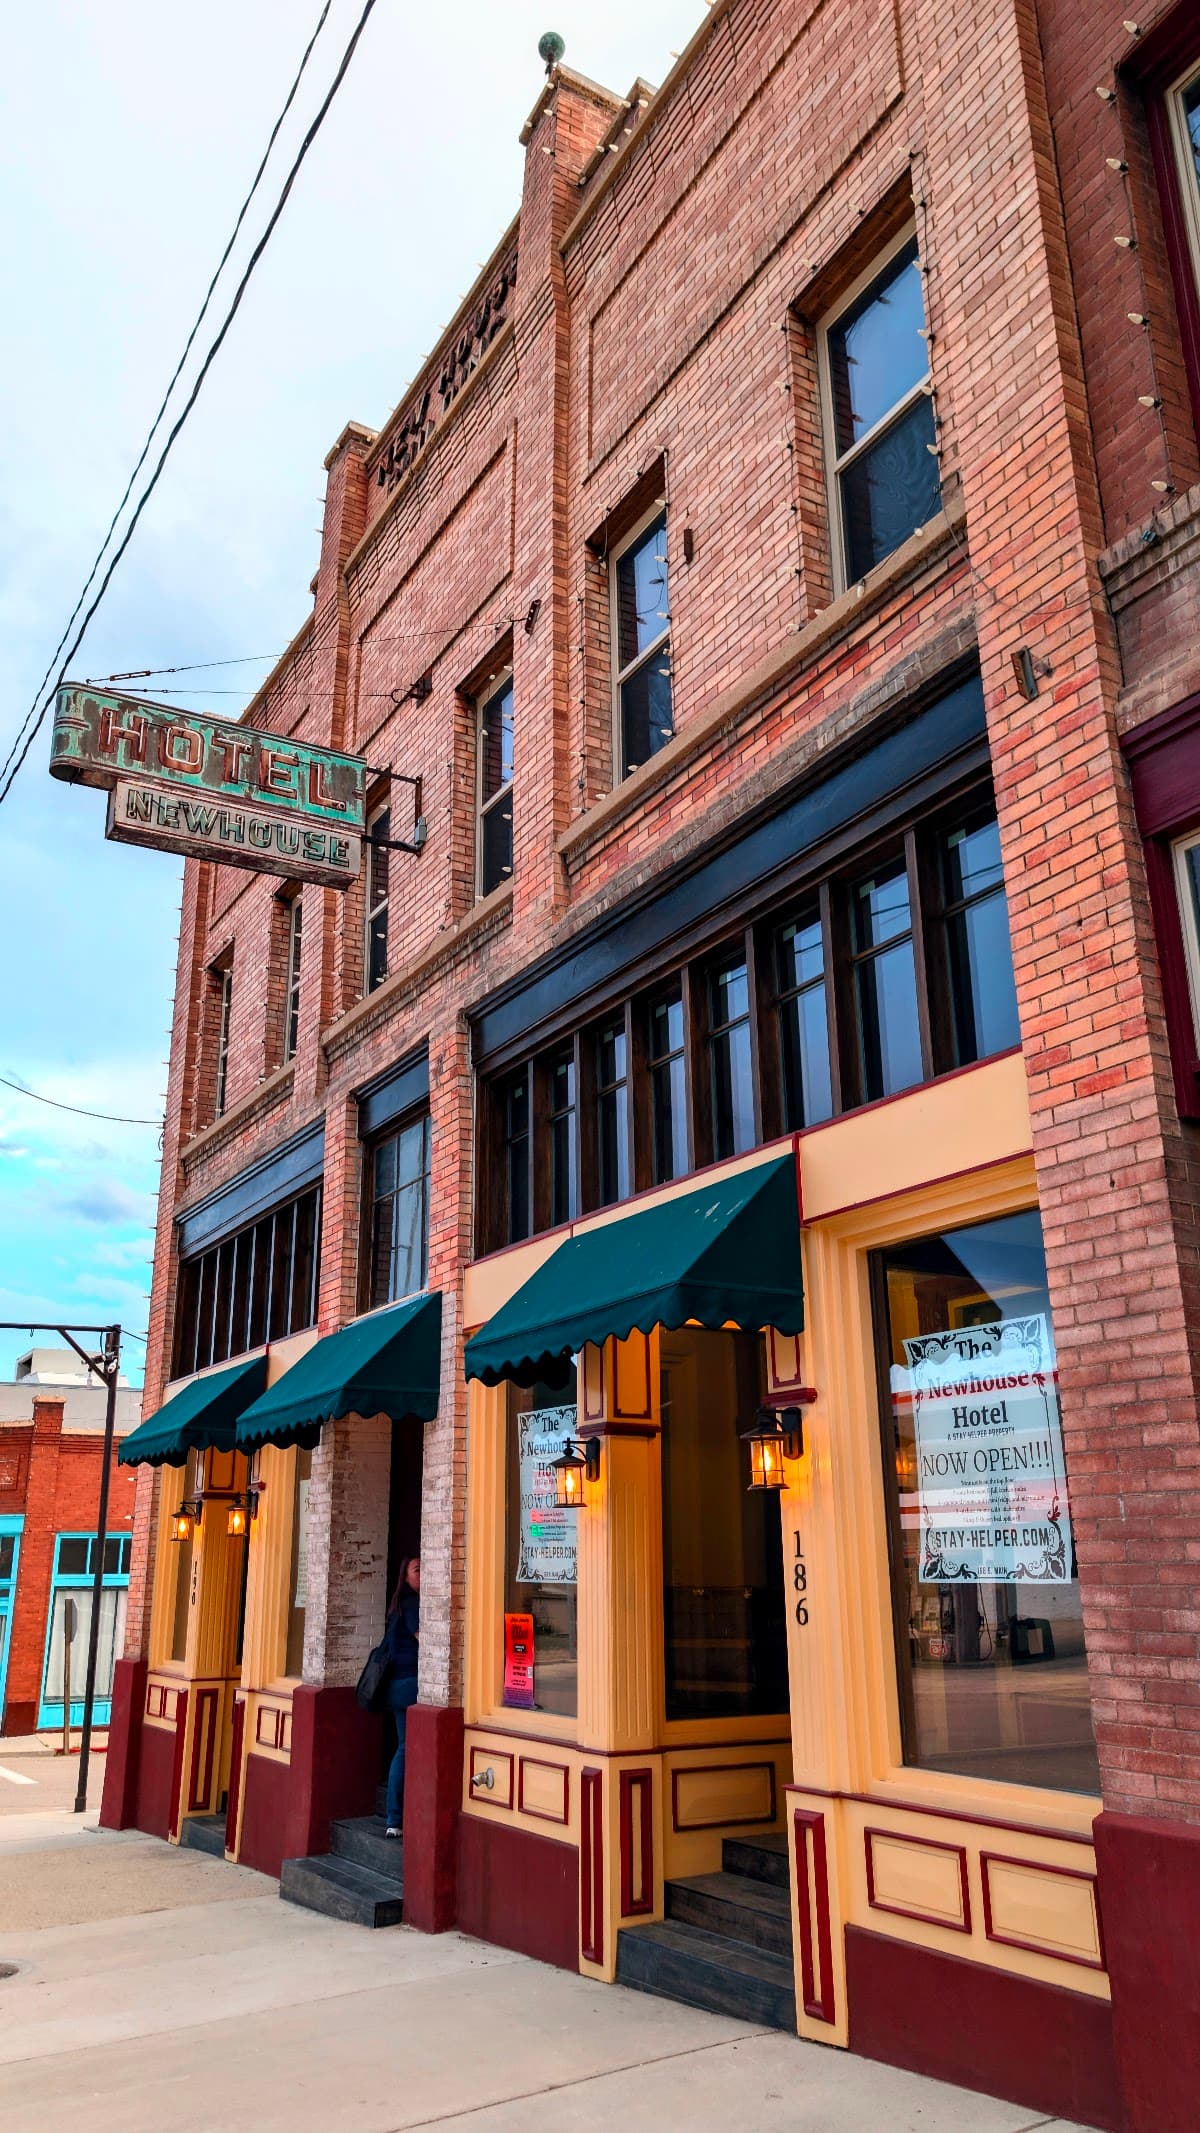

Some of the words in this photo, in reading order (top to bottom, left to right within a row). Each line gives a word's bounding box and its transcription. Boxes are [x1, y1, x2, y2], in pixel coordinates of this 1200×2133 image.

[376, 389, 431, 487] NEW
[98, 707, 347, 812] HOTEL
[126, 788, 351, 868] NEWHOUSE
[954, 1338, 992, 1363] The
[927, 1368, 1031, 1399] Newhouse
[542, 1417, 559, 1433] The
[951, 1400, 1009, 1429] Hotel
[526, 1438, 565, 1457] Newhou
[922, 1451, 968, 1478] NOW
[973, 1440, 1051, 1473] OPEN!!!
[522, 1493, 543, 1510] NOW
[935, 1527, 1050, 1548] STAY-HELPER.COM
[793, 1530, 808, 1626] 186
